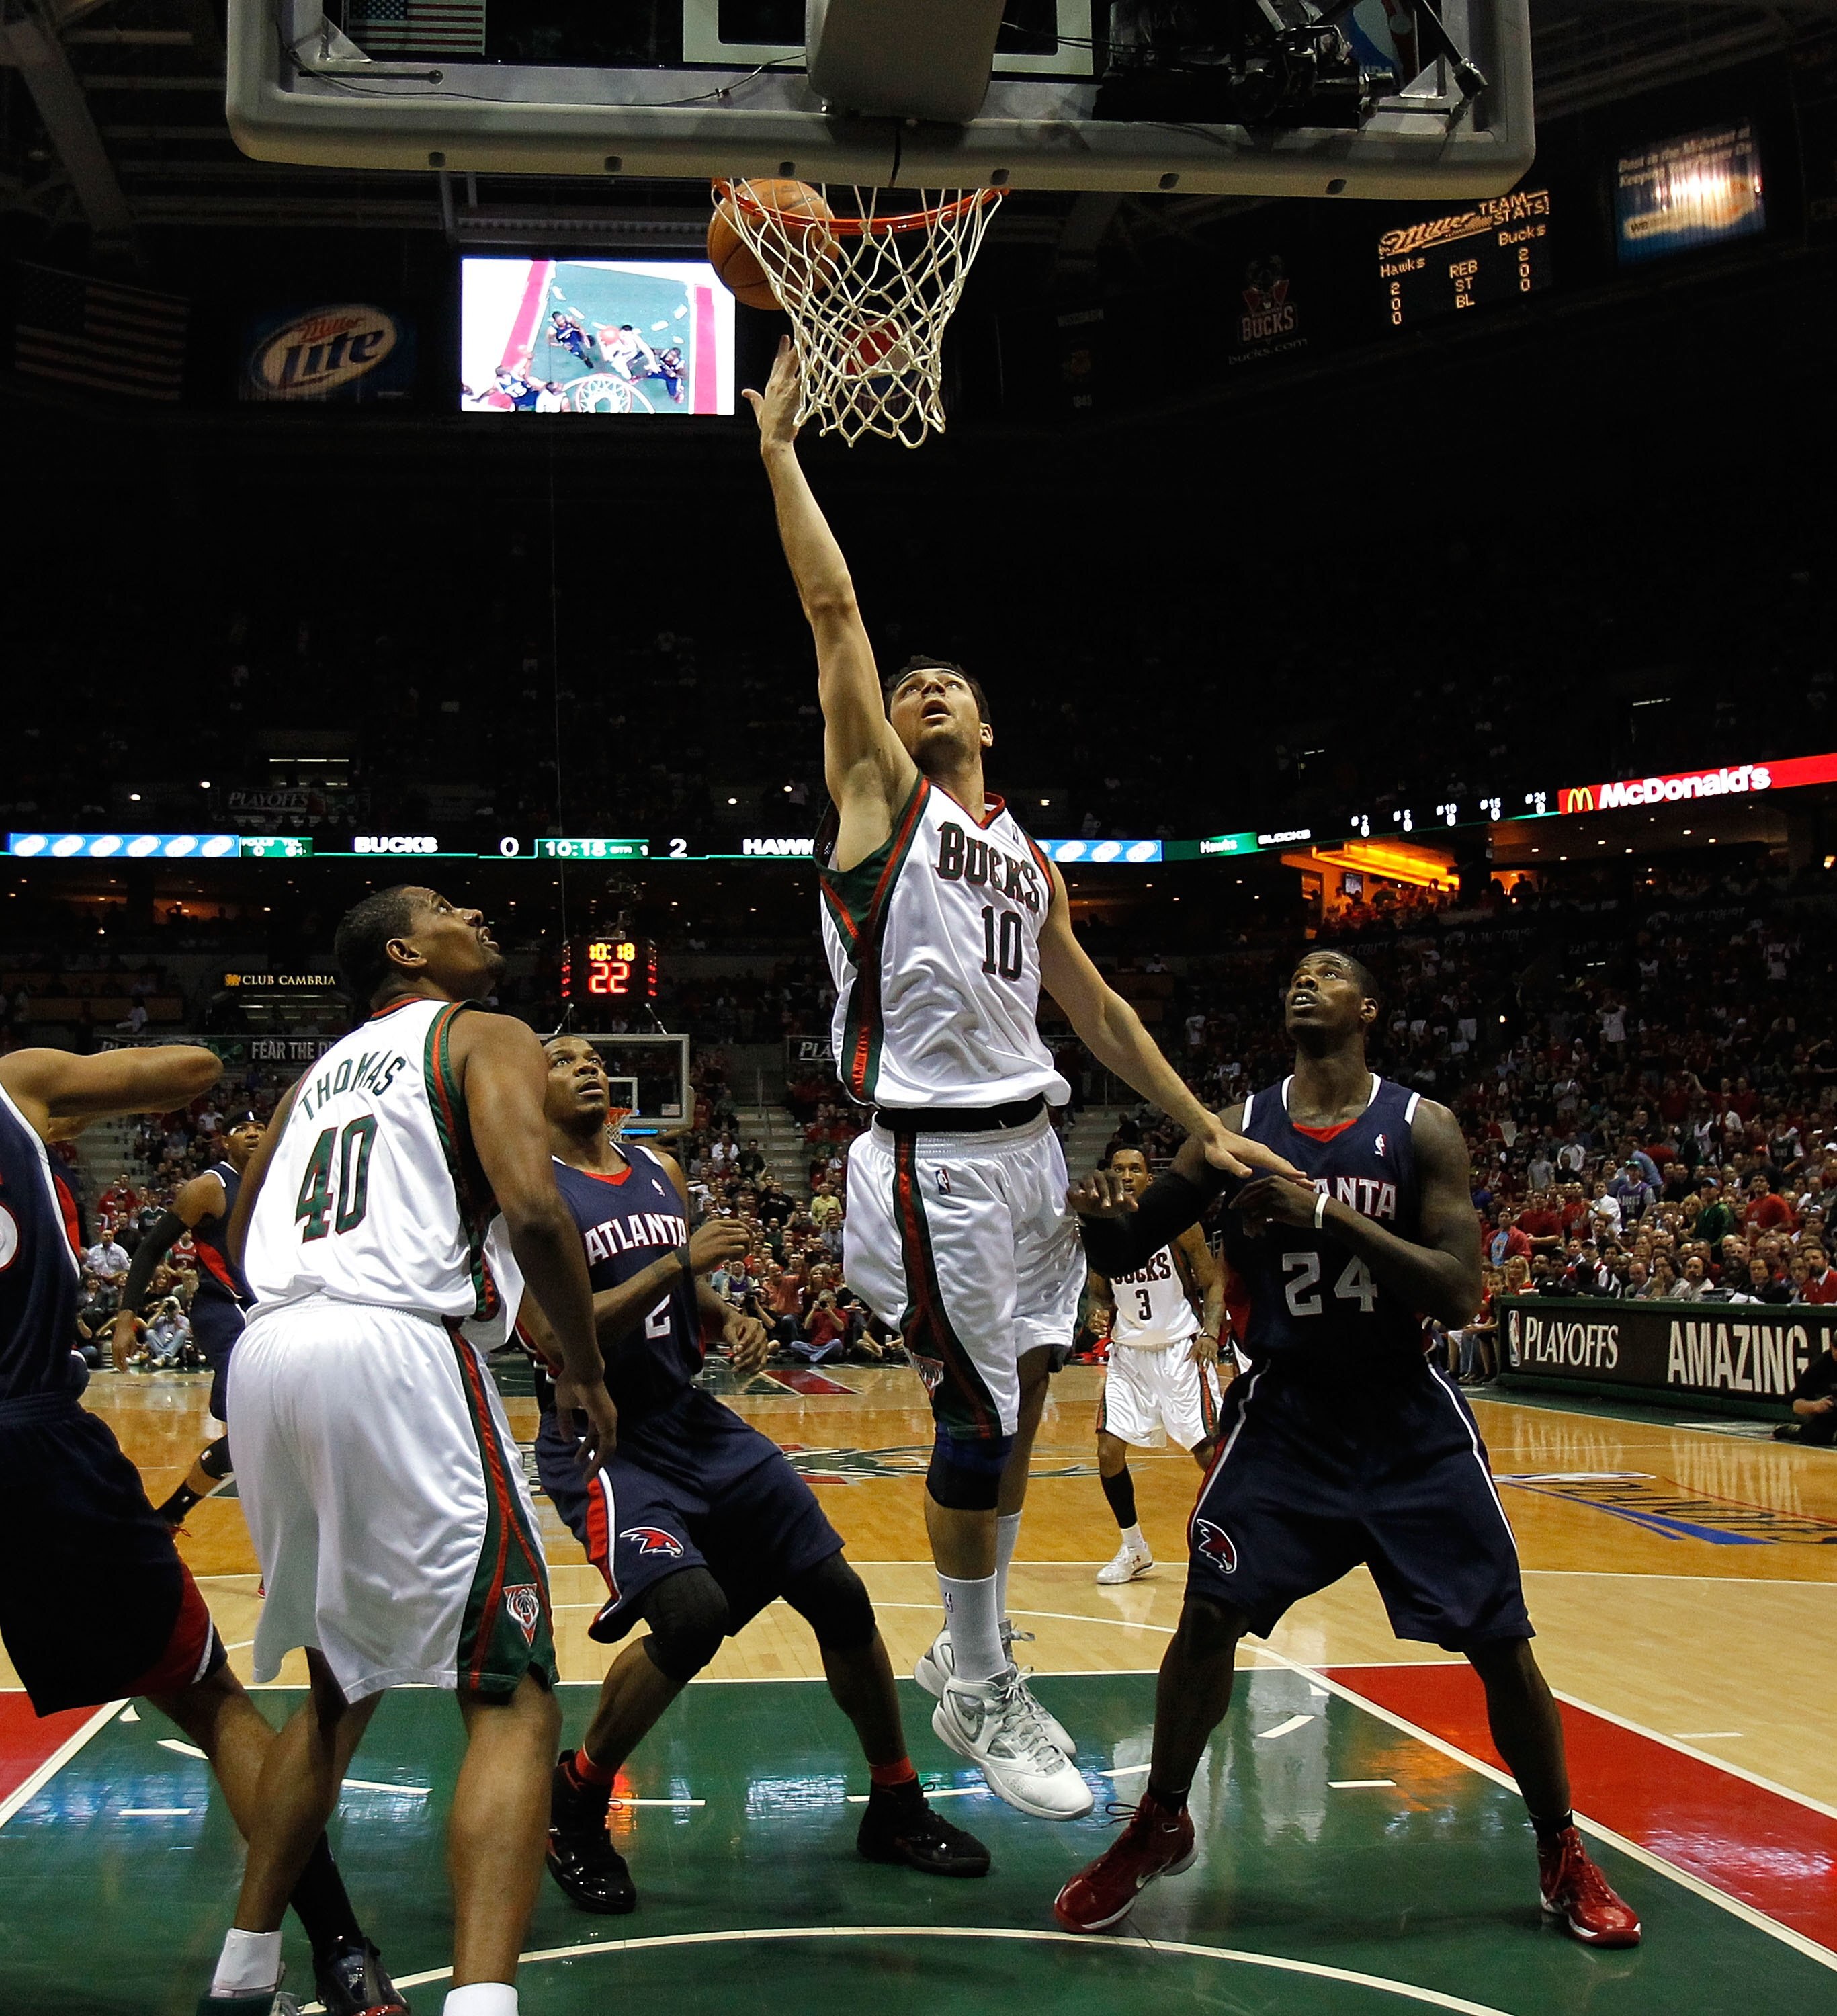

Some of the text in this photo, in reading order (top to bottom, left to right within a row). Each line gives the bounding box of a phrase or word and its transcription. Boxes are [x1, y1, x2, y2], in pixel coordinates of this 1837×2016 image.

[1479, 192, 1527, 215] TEAM
[1498, 224, 1546, 247] Bucks
[1519, 247, 1529, 261] 2
[1380, 257, 1426, 278] Hawks
[1449, 259, 1478, 278] REB
[1520, 263, 1529, 278] 0
[1390, 282, 1400, 295] 2
[1455, 277, 1473, 292] ST
[1521, 278, 1530, 292] 0
[1392, 298, 1401, 310] 0
[1457, 294, 1475, 308] BL
[1242, 304, 1295, 342] BUCKS
[1392, 311, 1402, 325] 0
[300, 316, 364, 344] Miller
[277, 329, 385, 390] Lite
[1228, 338, 1308, 366] bucks.com
[1599, 765, 1772, 810] McDonald's
[229, 792, 309, 807] PLAYOFFS
[354, 837, 438, 853] BUCKS
[500, 837, 519, 857] 0
[1200, 838, 1238, 853] Hawks
[1258, 829, 1311, 845] BLOCKS
[545, 841, 607, 857] 10:18
[640, 845, 648, 856] 1
[669, 838, 687, 858] 2
[935, 821, 1039, 913] BUCKS
[589, 942, 636, 962] 10:18
[982, 905, 1022, 981] 10
[242, 975, 336, 985] CLUB CAMBRIA
[588, 962, 630, 993] 22
[251, 1041, 286, 1060] FEAR
[288, 1042, 316, 1060] THE
[298, 1050, 407, 1121] THOMAS
[294, 1113, 379, 1245] 40
[584, 1212, 687, 1267] ATLANTA
[1281, 1251, 1378, 1316] 24
[1135, 1288, 1152, 1321] 3
[644, 1294, 671, 1339] 2
[1524, 1316, 1809, 1396] PLAYOFFS AMAZING
